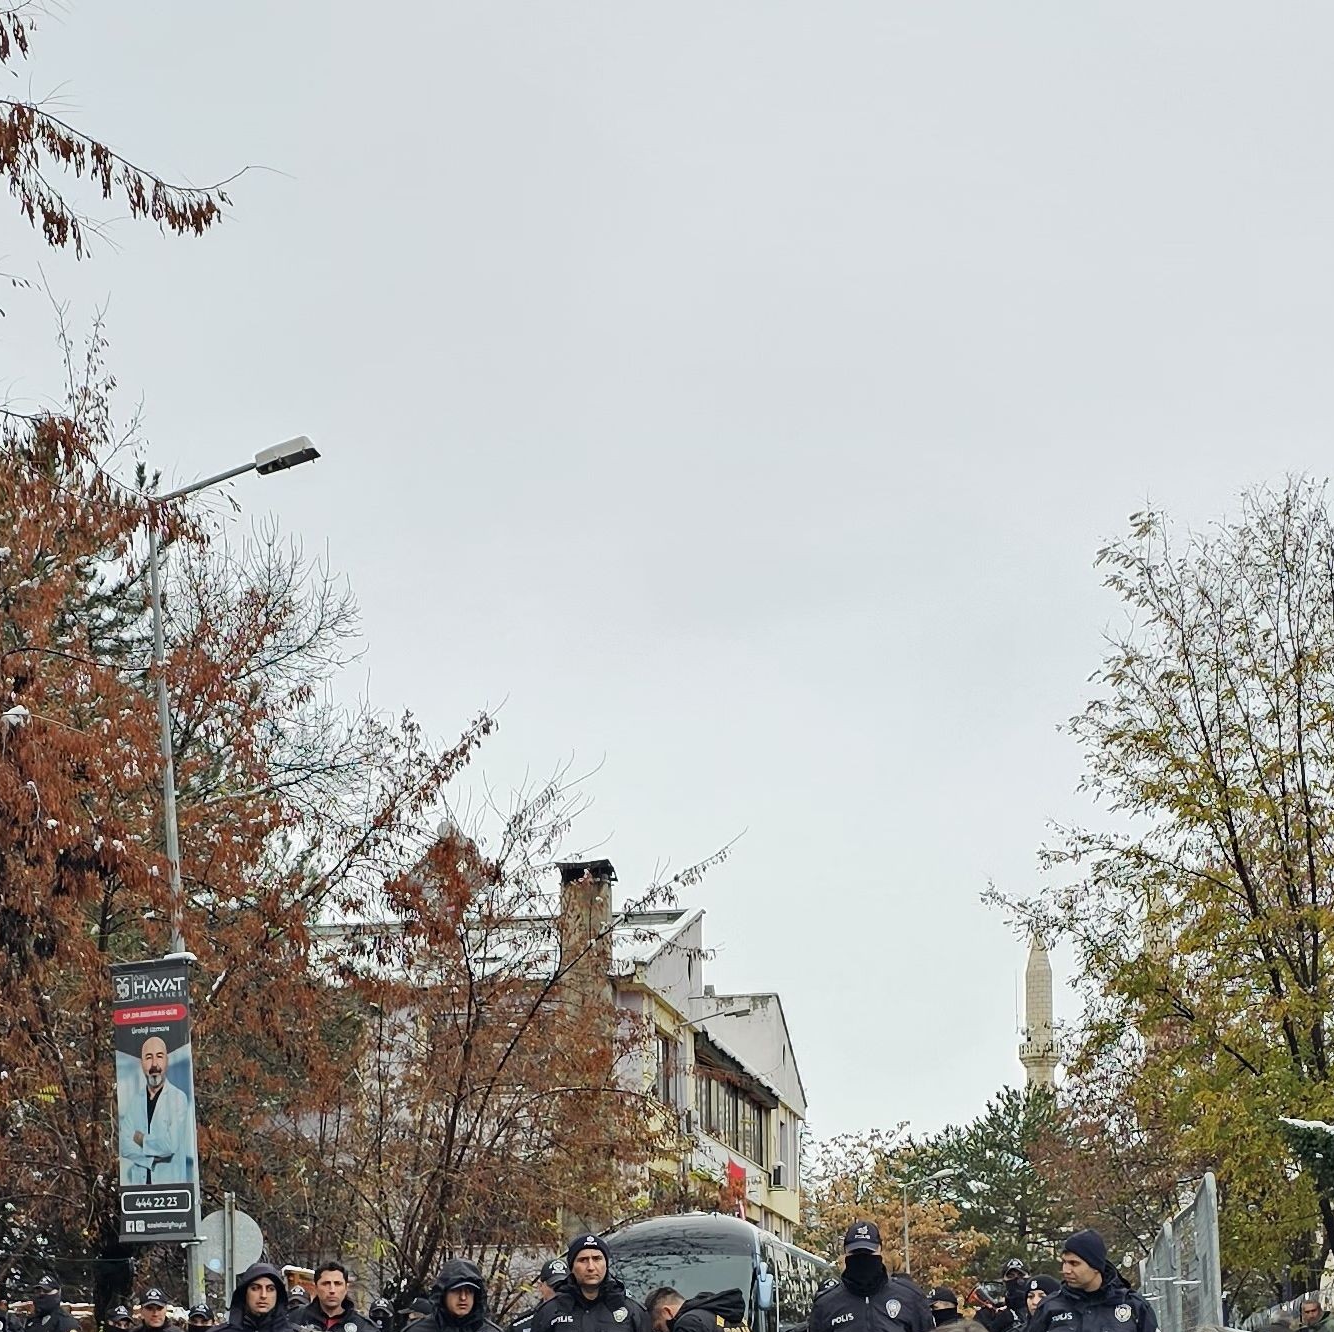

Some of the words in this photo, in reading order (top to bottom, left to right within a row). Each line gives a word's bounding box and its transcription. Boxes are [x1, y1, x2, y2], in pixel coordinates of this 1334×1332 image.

[134, 977, 185, 994] HAYAT
[135, 1197, 153, 1208] 444
[153, 1197, 165, 1208] 22
[166, 1196, 178, 1207] 23
